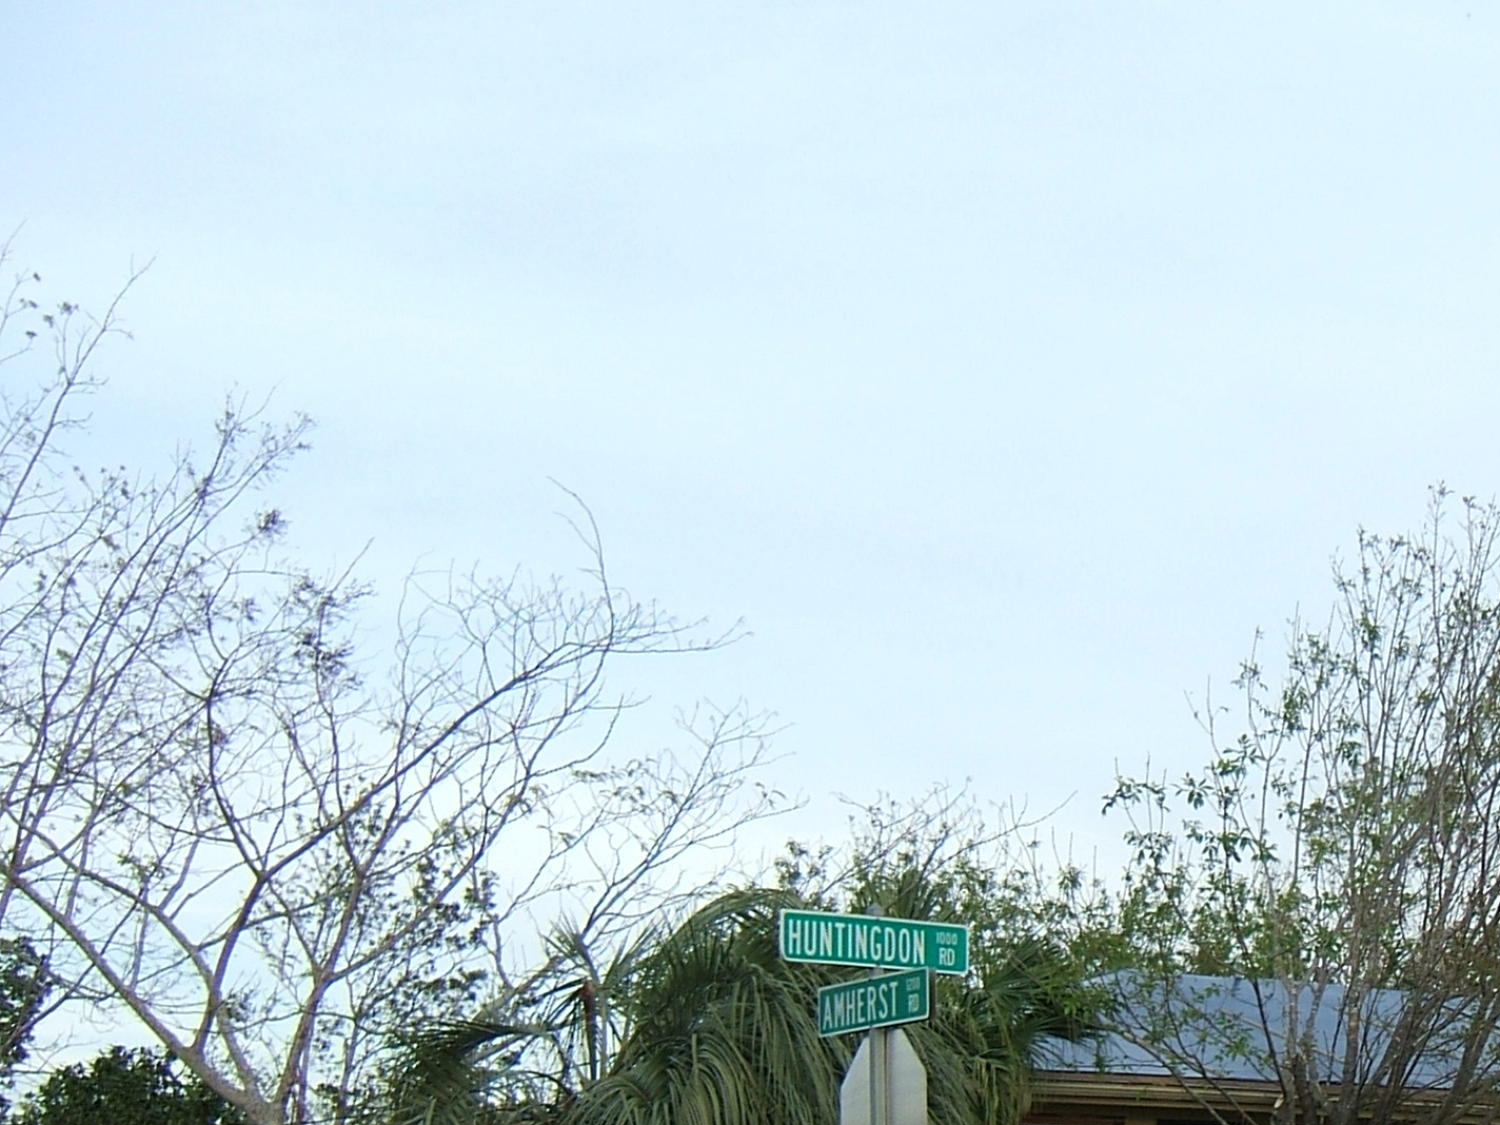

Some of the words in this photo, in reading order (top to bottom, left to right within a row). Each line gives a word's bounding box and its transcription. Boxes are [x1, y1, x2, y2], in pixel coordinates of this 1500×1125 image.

[788, 919, 925, 965] HUNTINGDON
[939, 947, 955, 966] RD
[822, 981, 899, 1030] AMHERST
[908, 993, 920, 1013] RD
